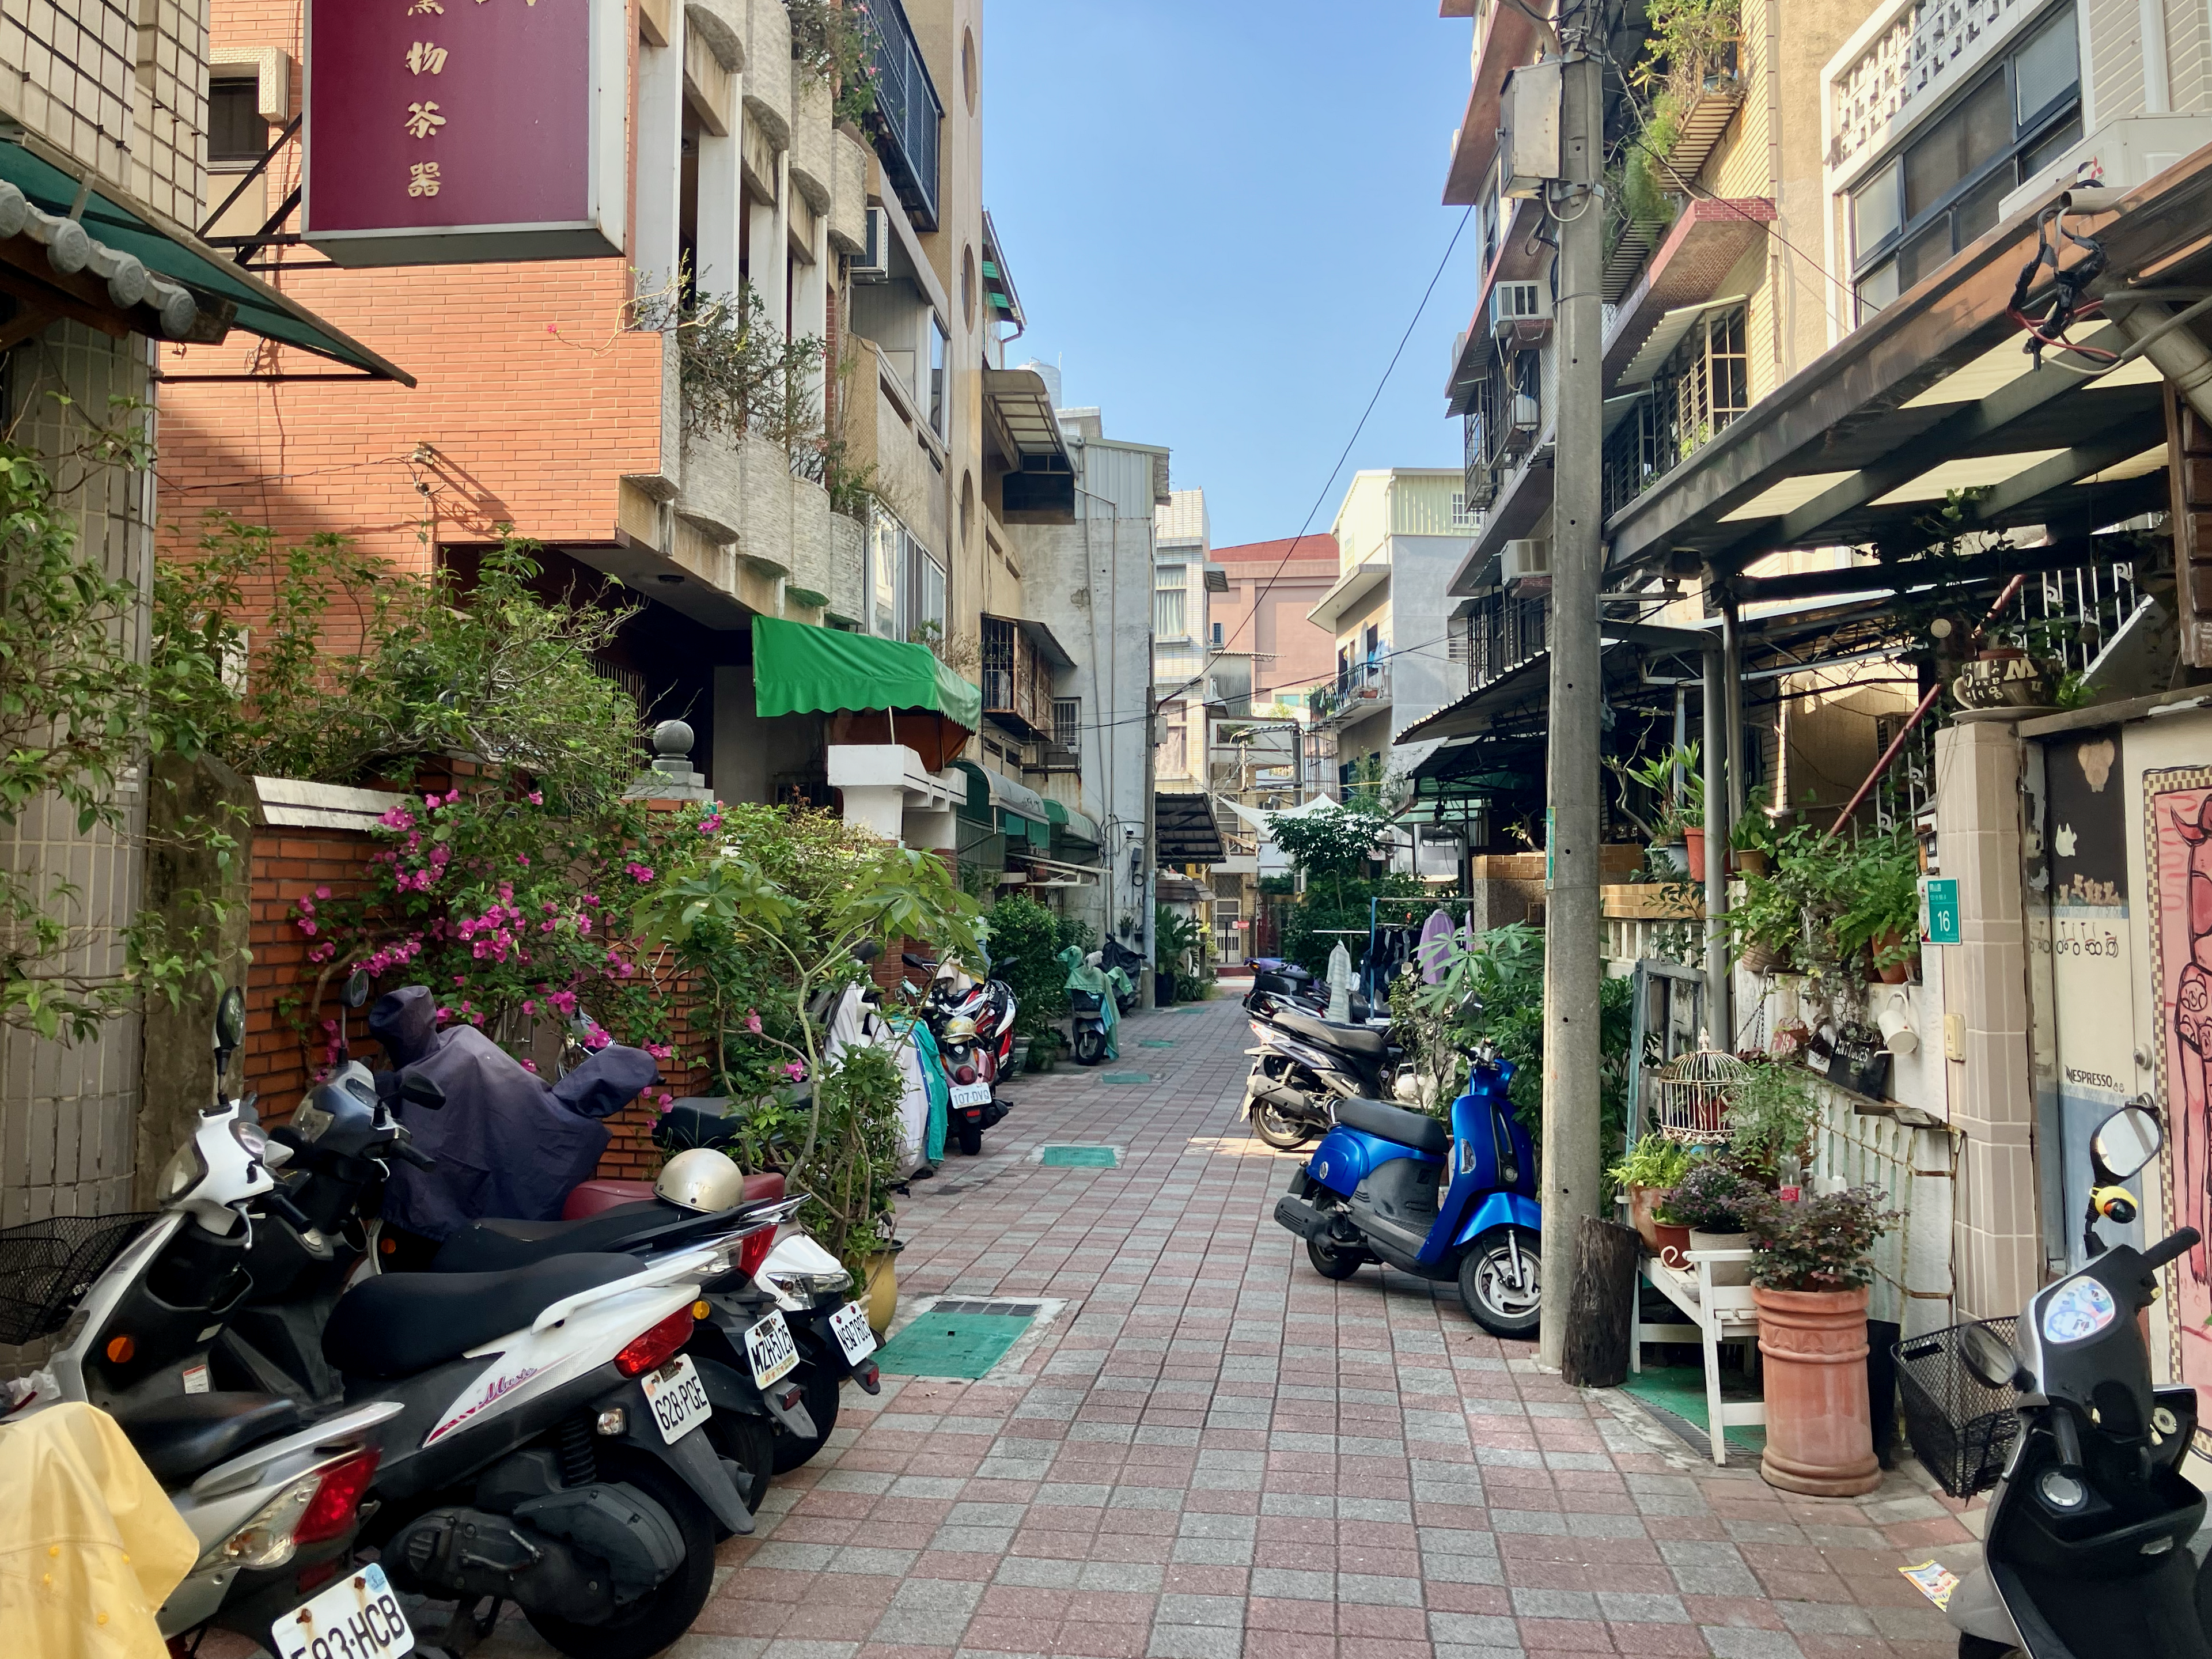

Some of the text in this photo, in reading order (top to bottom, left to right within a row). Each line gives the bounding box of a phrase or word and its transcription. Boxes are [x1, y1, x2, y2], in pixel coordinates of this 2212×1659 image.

[1937, 910, 1950, 932] 16
[2065, 1065, 2112, 1088] NESPRESSO
[751, 1324, 793, 1376] MZH-5125
[290, 1594, 405, 1659] 93-HCB
